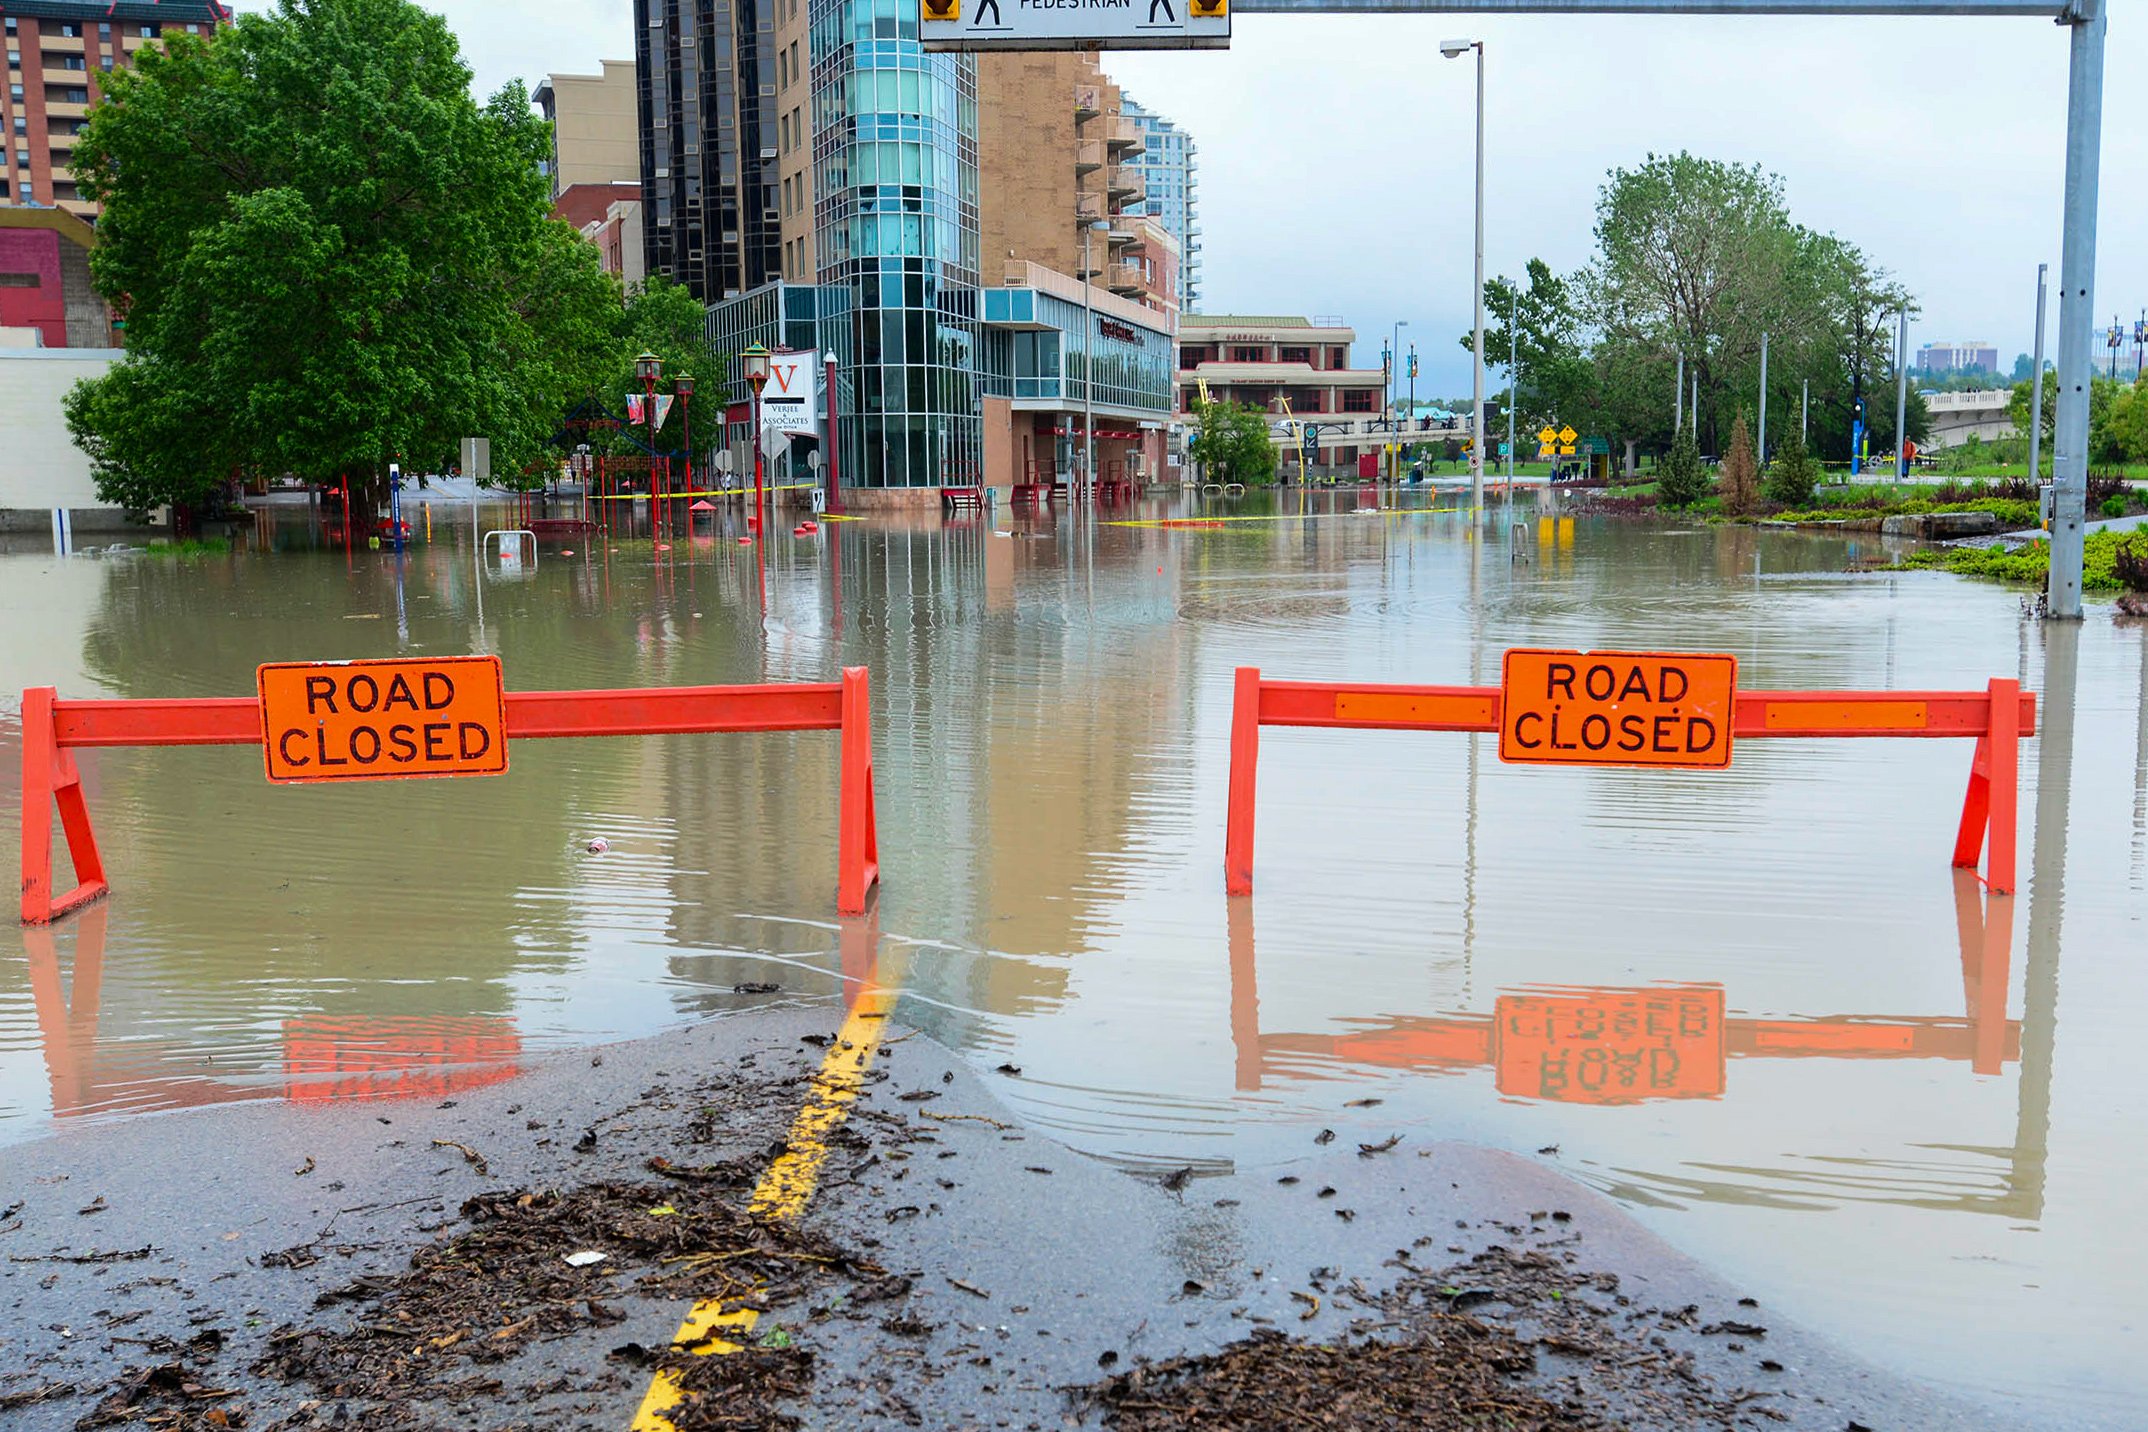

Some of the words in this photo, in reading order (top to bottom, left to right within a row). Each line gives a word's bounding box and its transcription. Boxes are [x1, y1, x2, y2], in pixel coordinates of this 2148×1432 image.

[770, 365, 798, 393] V
[762, 417, 809, 425] ASSOCIATES
[771, 405, 799, 413] VERJEE
[1500, 445, 1507, 453] P
[306, 672, 455, 714] ROAD
[1546, 663, 1689, 703] ROAD
[279, 721, 490, 767] CLOSED
[1514, 711, 1717, 753] CLOSED
